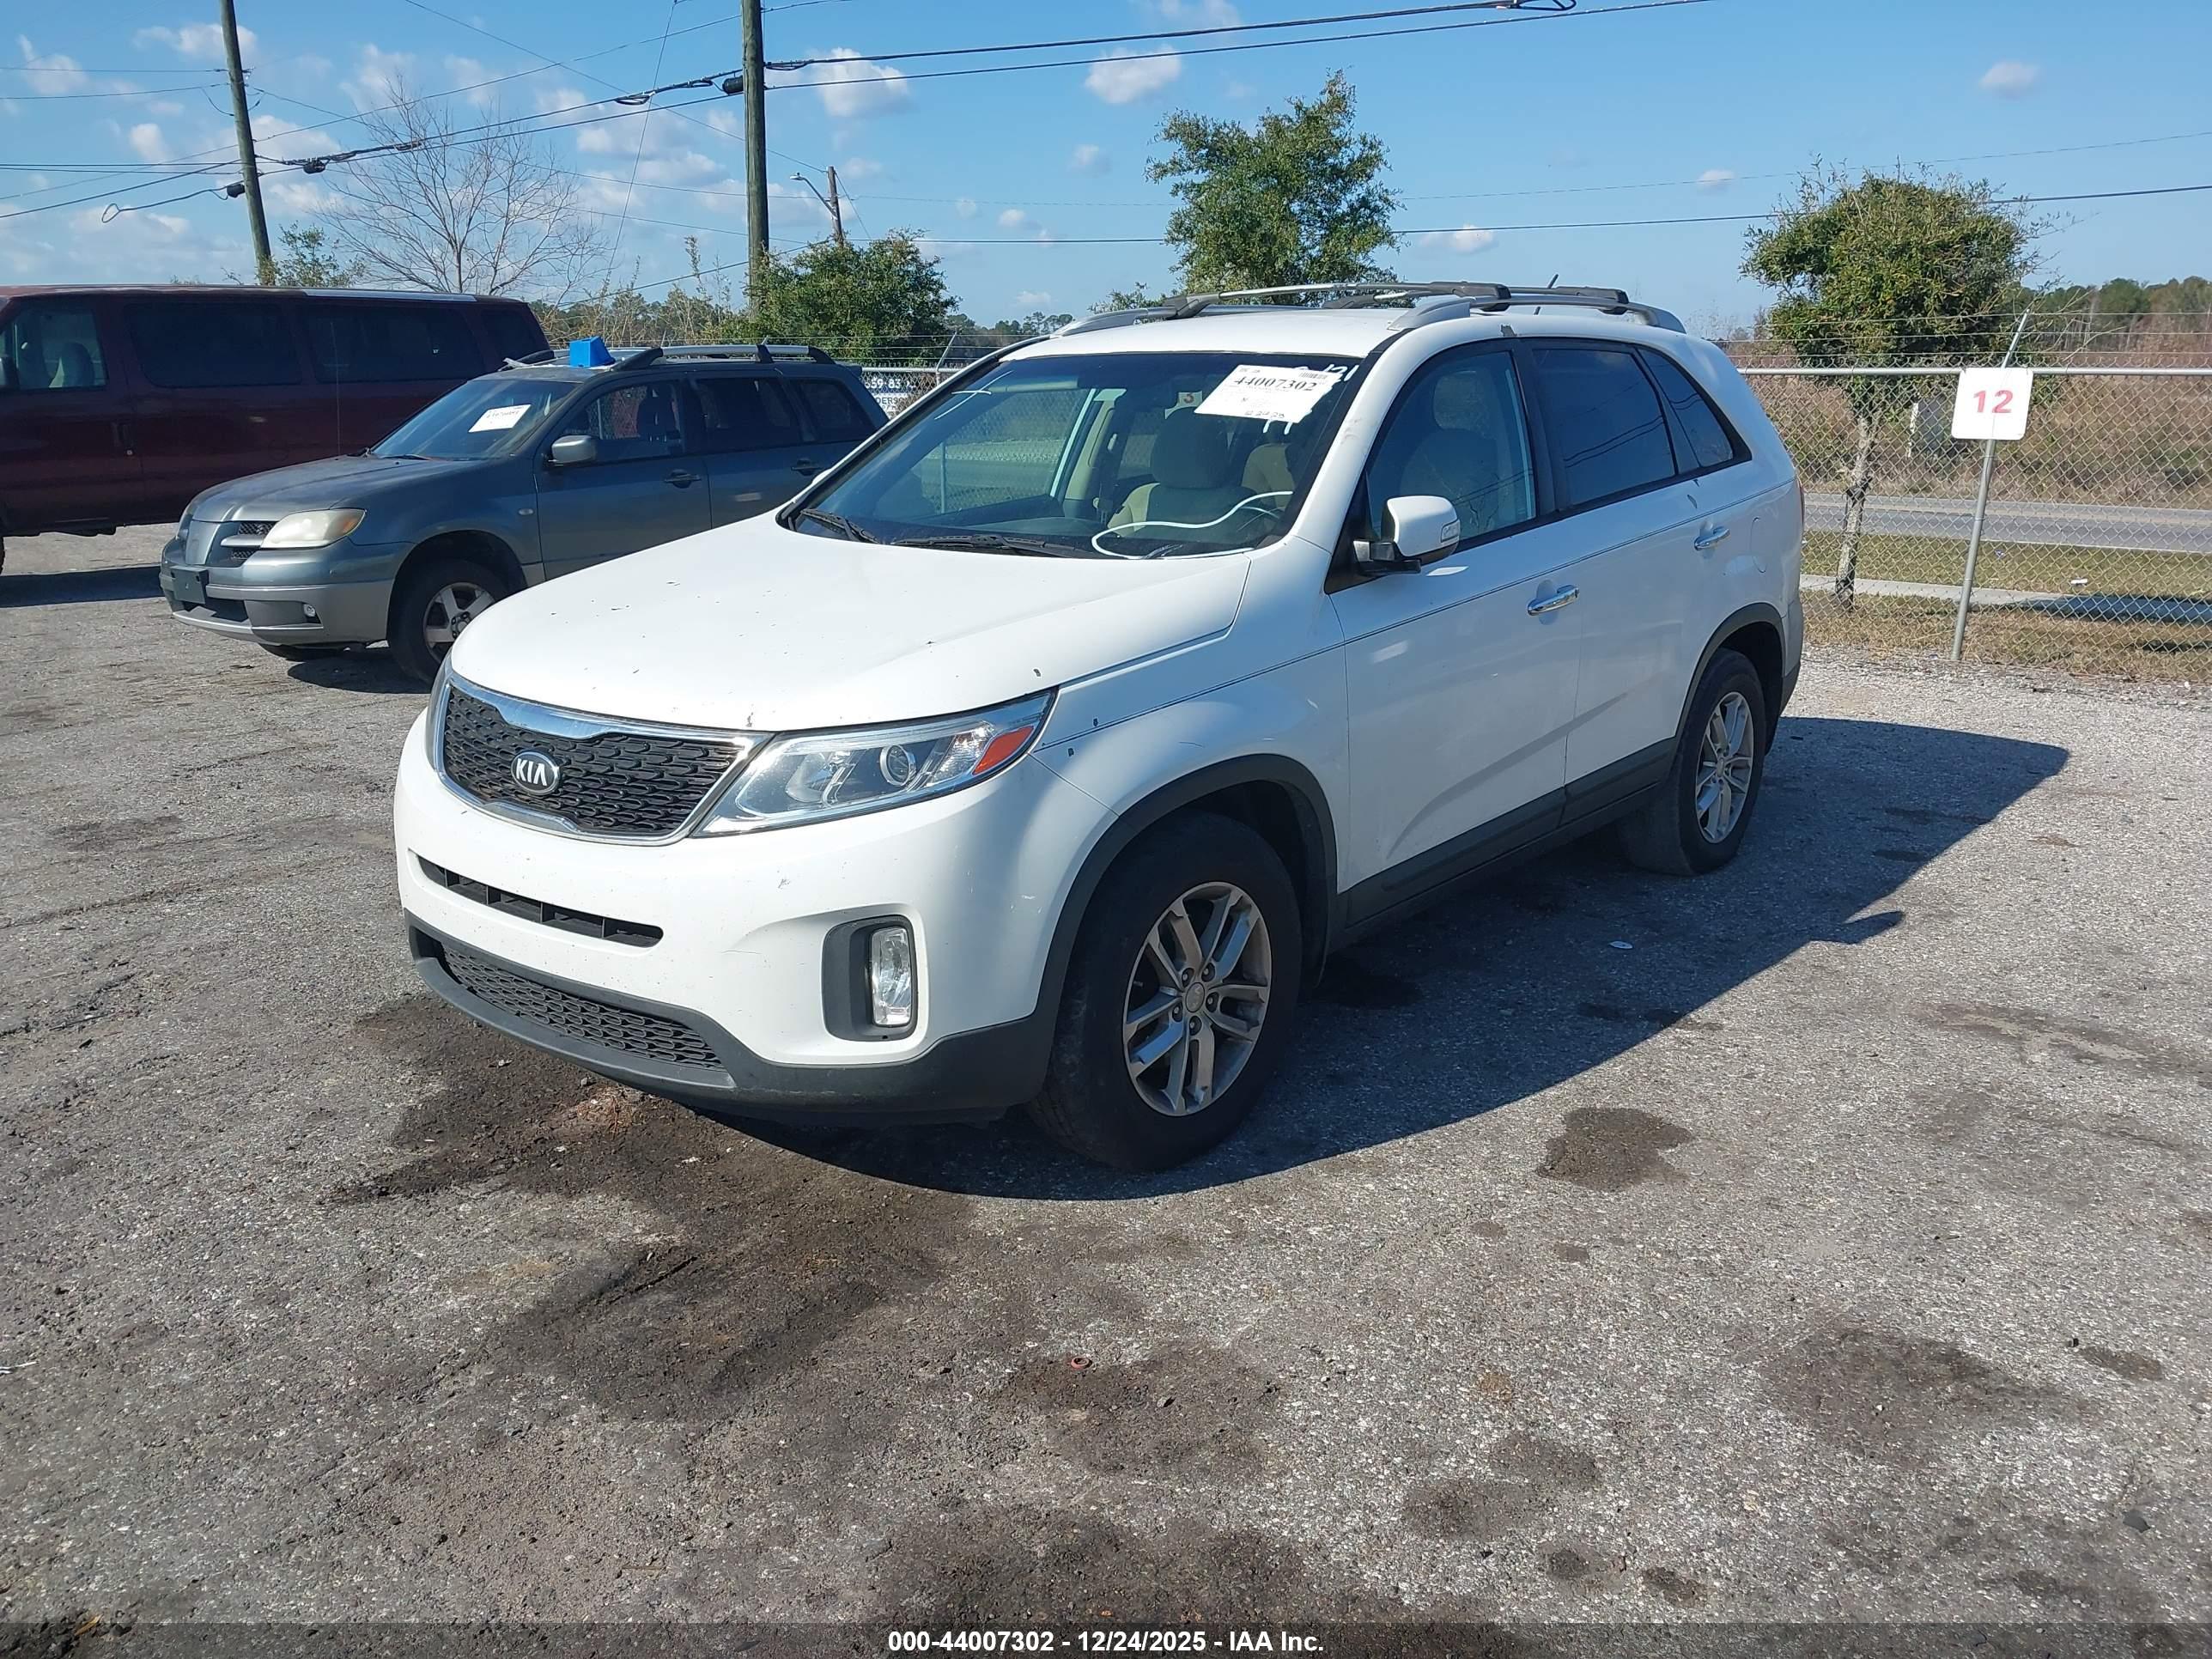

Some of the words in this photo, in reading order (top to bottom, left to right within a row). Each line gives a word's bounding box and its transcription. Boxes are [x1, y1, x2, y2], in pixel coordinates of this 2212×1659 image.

[1234, 376, 1317, 392] 44007302
[1973, 390, 2014, 414] 12
[515, 758, 548, 787] KIA
